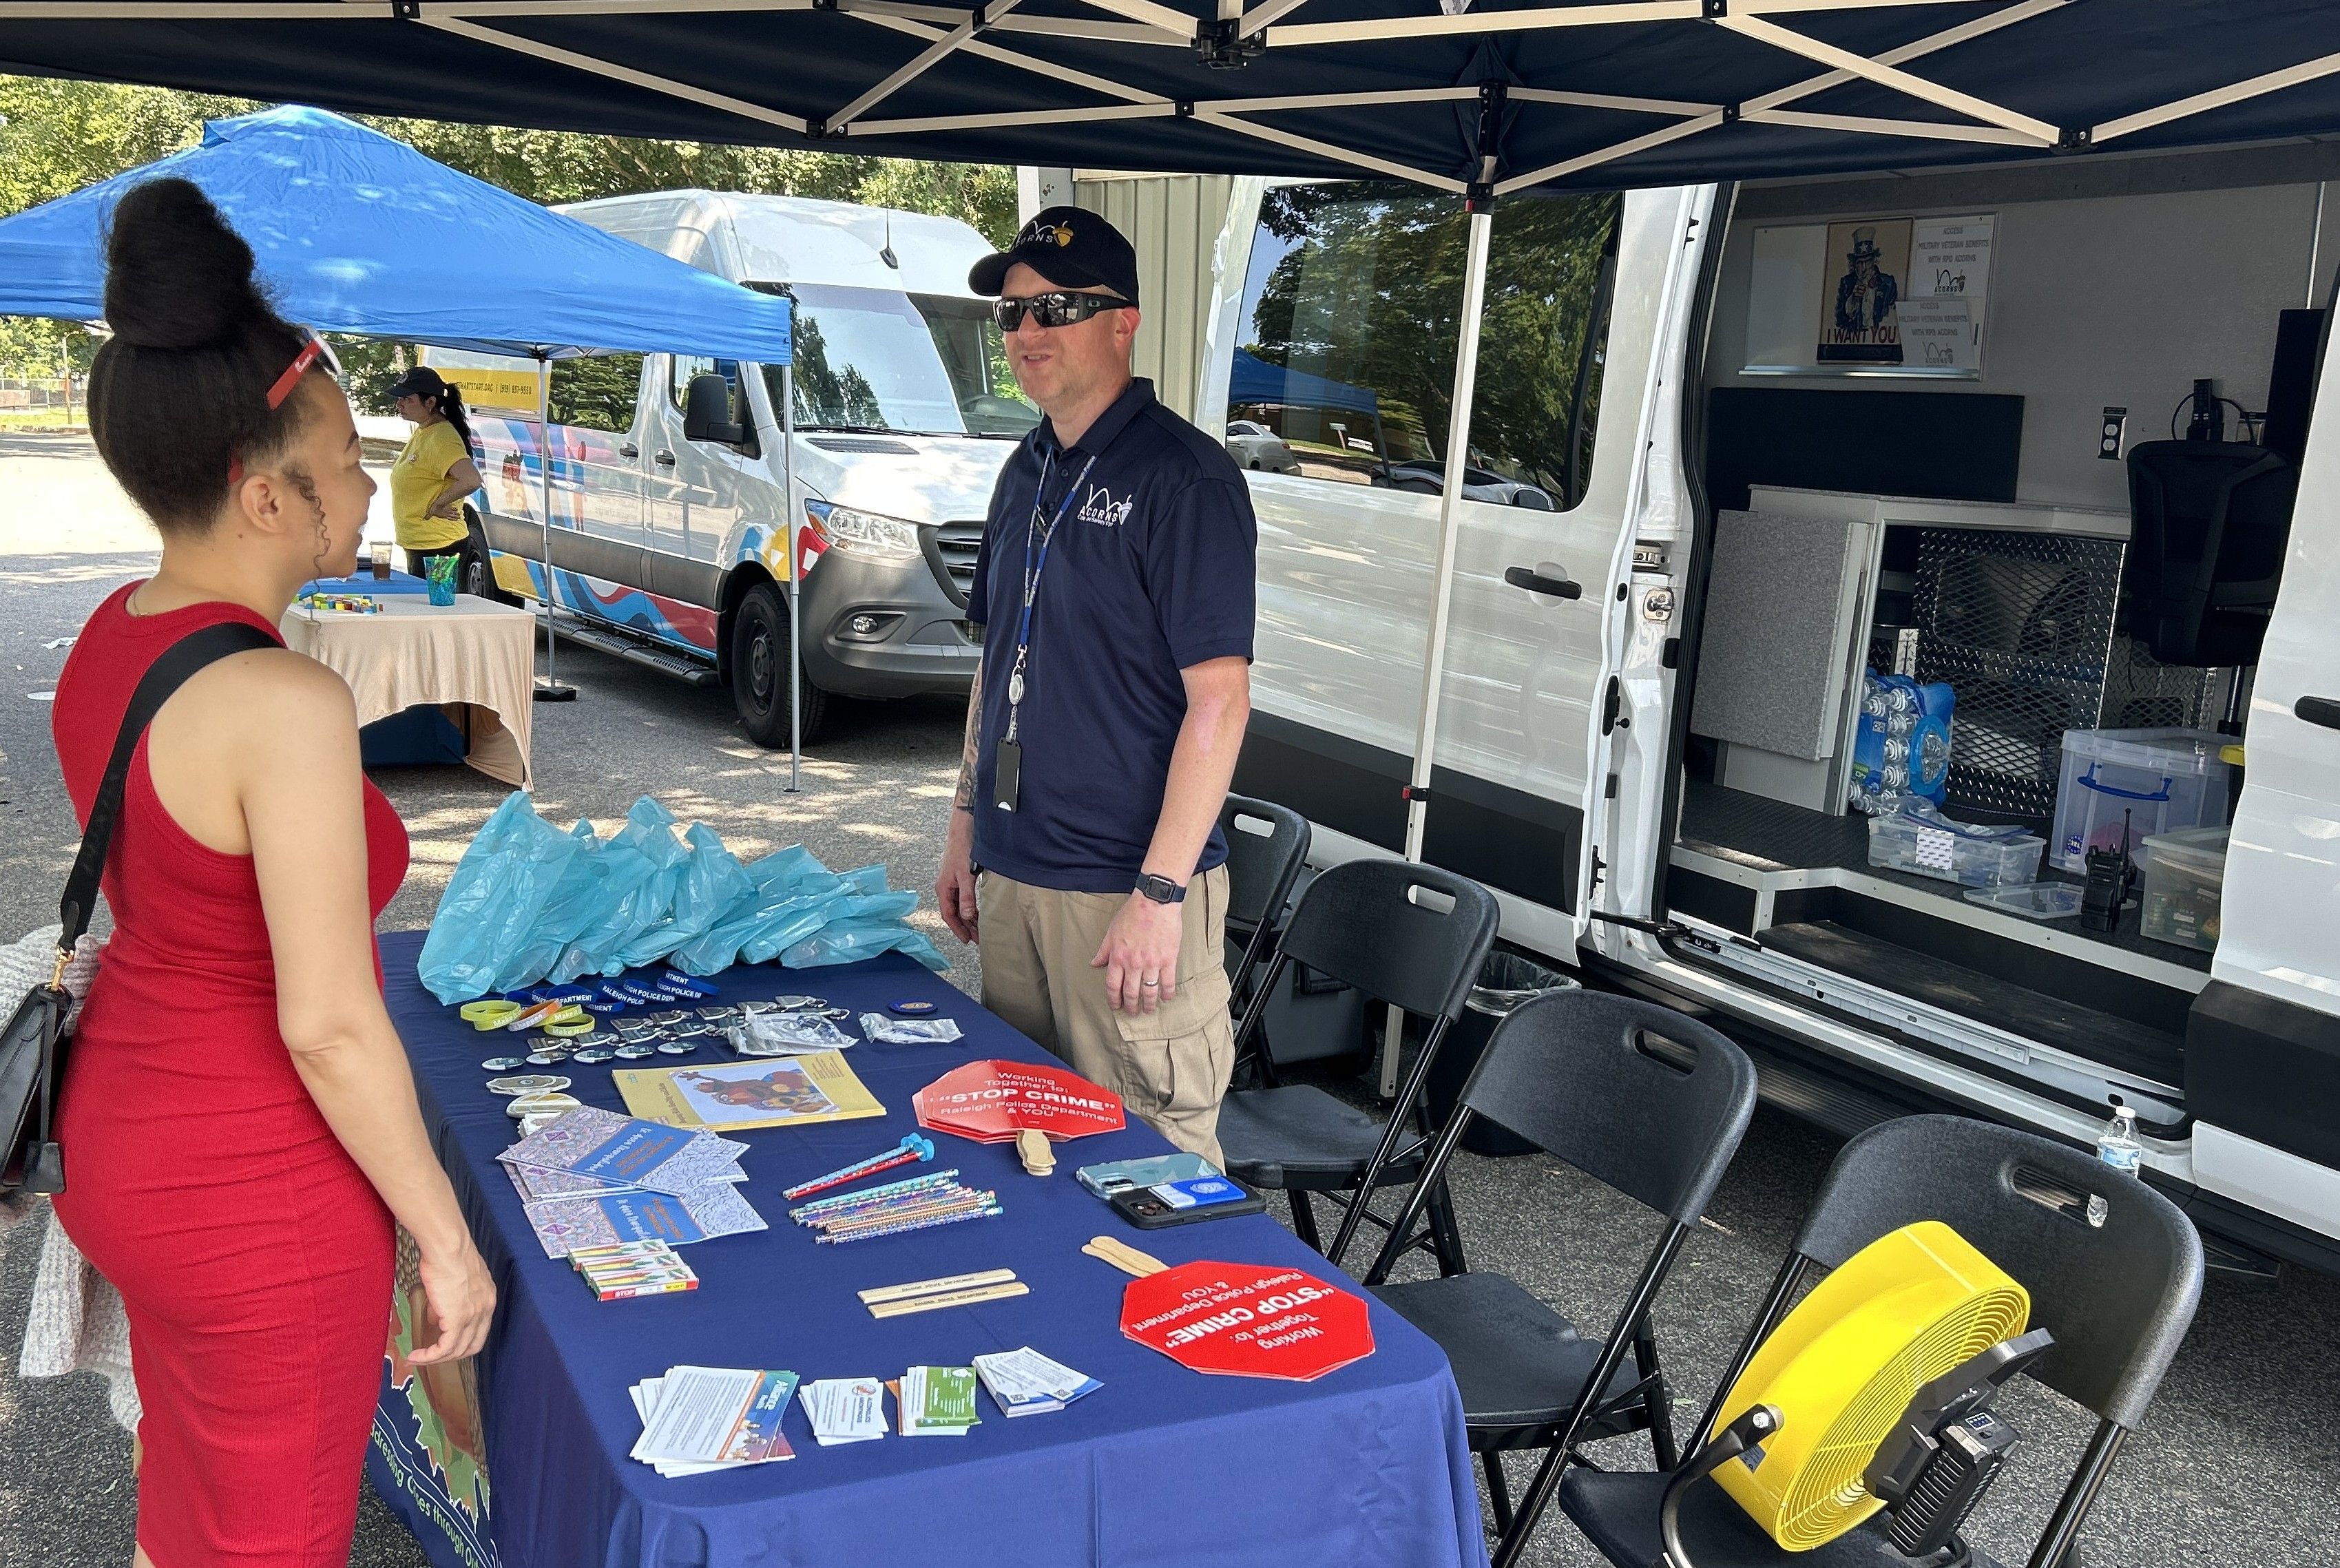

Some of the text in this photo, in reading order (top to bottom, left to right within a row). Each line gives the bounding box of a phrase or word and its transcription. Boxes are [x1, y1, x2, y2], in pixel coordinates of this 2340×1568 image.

[1943, 227, 1963, 235] ACCESS
[1919, 239, 1989, 250] MILITARY VETERAN BENEFITS
[1954, 254, 1976, 262] ACORNS
[1944, 315, 1968, 323] BENEFITS
[1827, 326, 1897, 343] I WANT YOU
[1079, 505, 1118, 523] ACORNS
[603, 985, 626, 1001] RALEIGH
[638, 989, 661, 1001] POLICE
[671, 987, 694, 997] POLICE
[493, 1016, 513, 1027] Make
[517, 1014, 543, 1029] happen
[554, 1011, 572, 1021] Make
[552, 1027, 573, 1036] Make
[985, 1079, 1047, 1091] Together
[998, 1072, 1055, 1086] Working
[941, 1100, 1118, 1125] Raleigh Police Department
[1023, 1109, 1055, 1118] YOU
[1180, 1279, 1230, 1302] & YOU
[1131, 1271, 1304, 1332] Raleigh Police Department
[1252, 1311, 1320, 1339] Together
[1256, 1324, 1324, 1351] Working
[370, 1423, 405, 1487] ddressing
[432, 1505, 464, 1558] through
